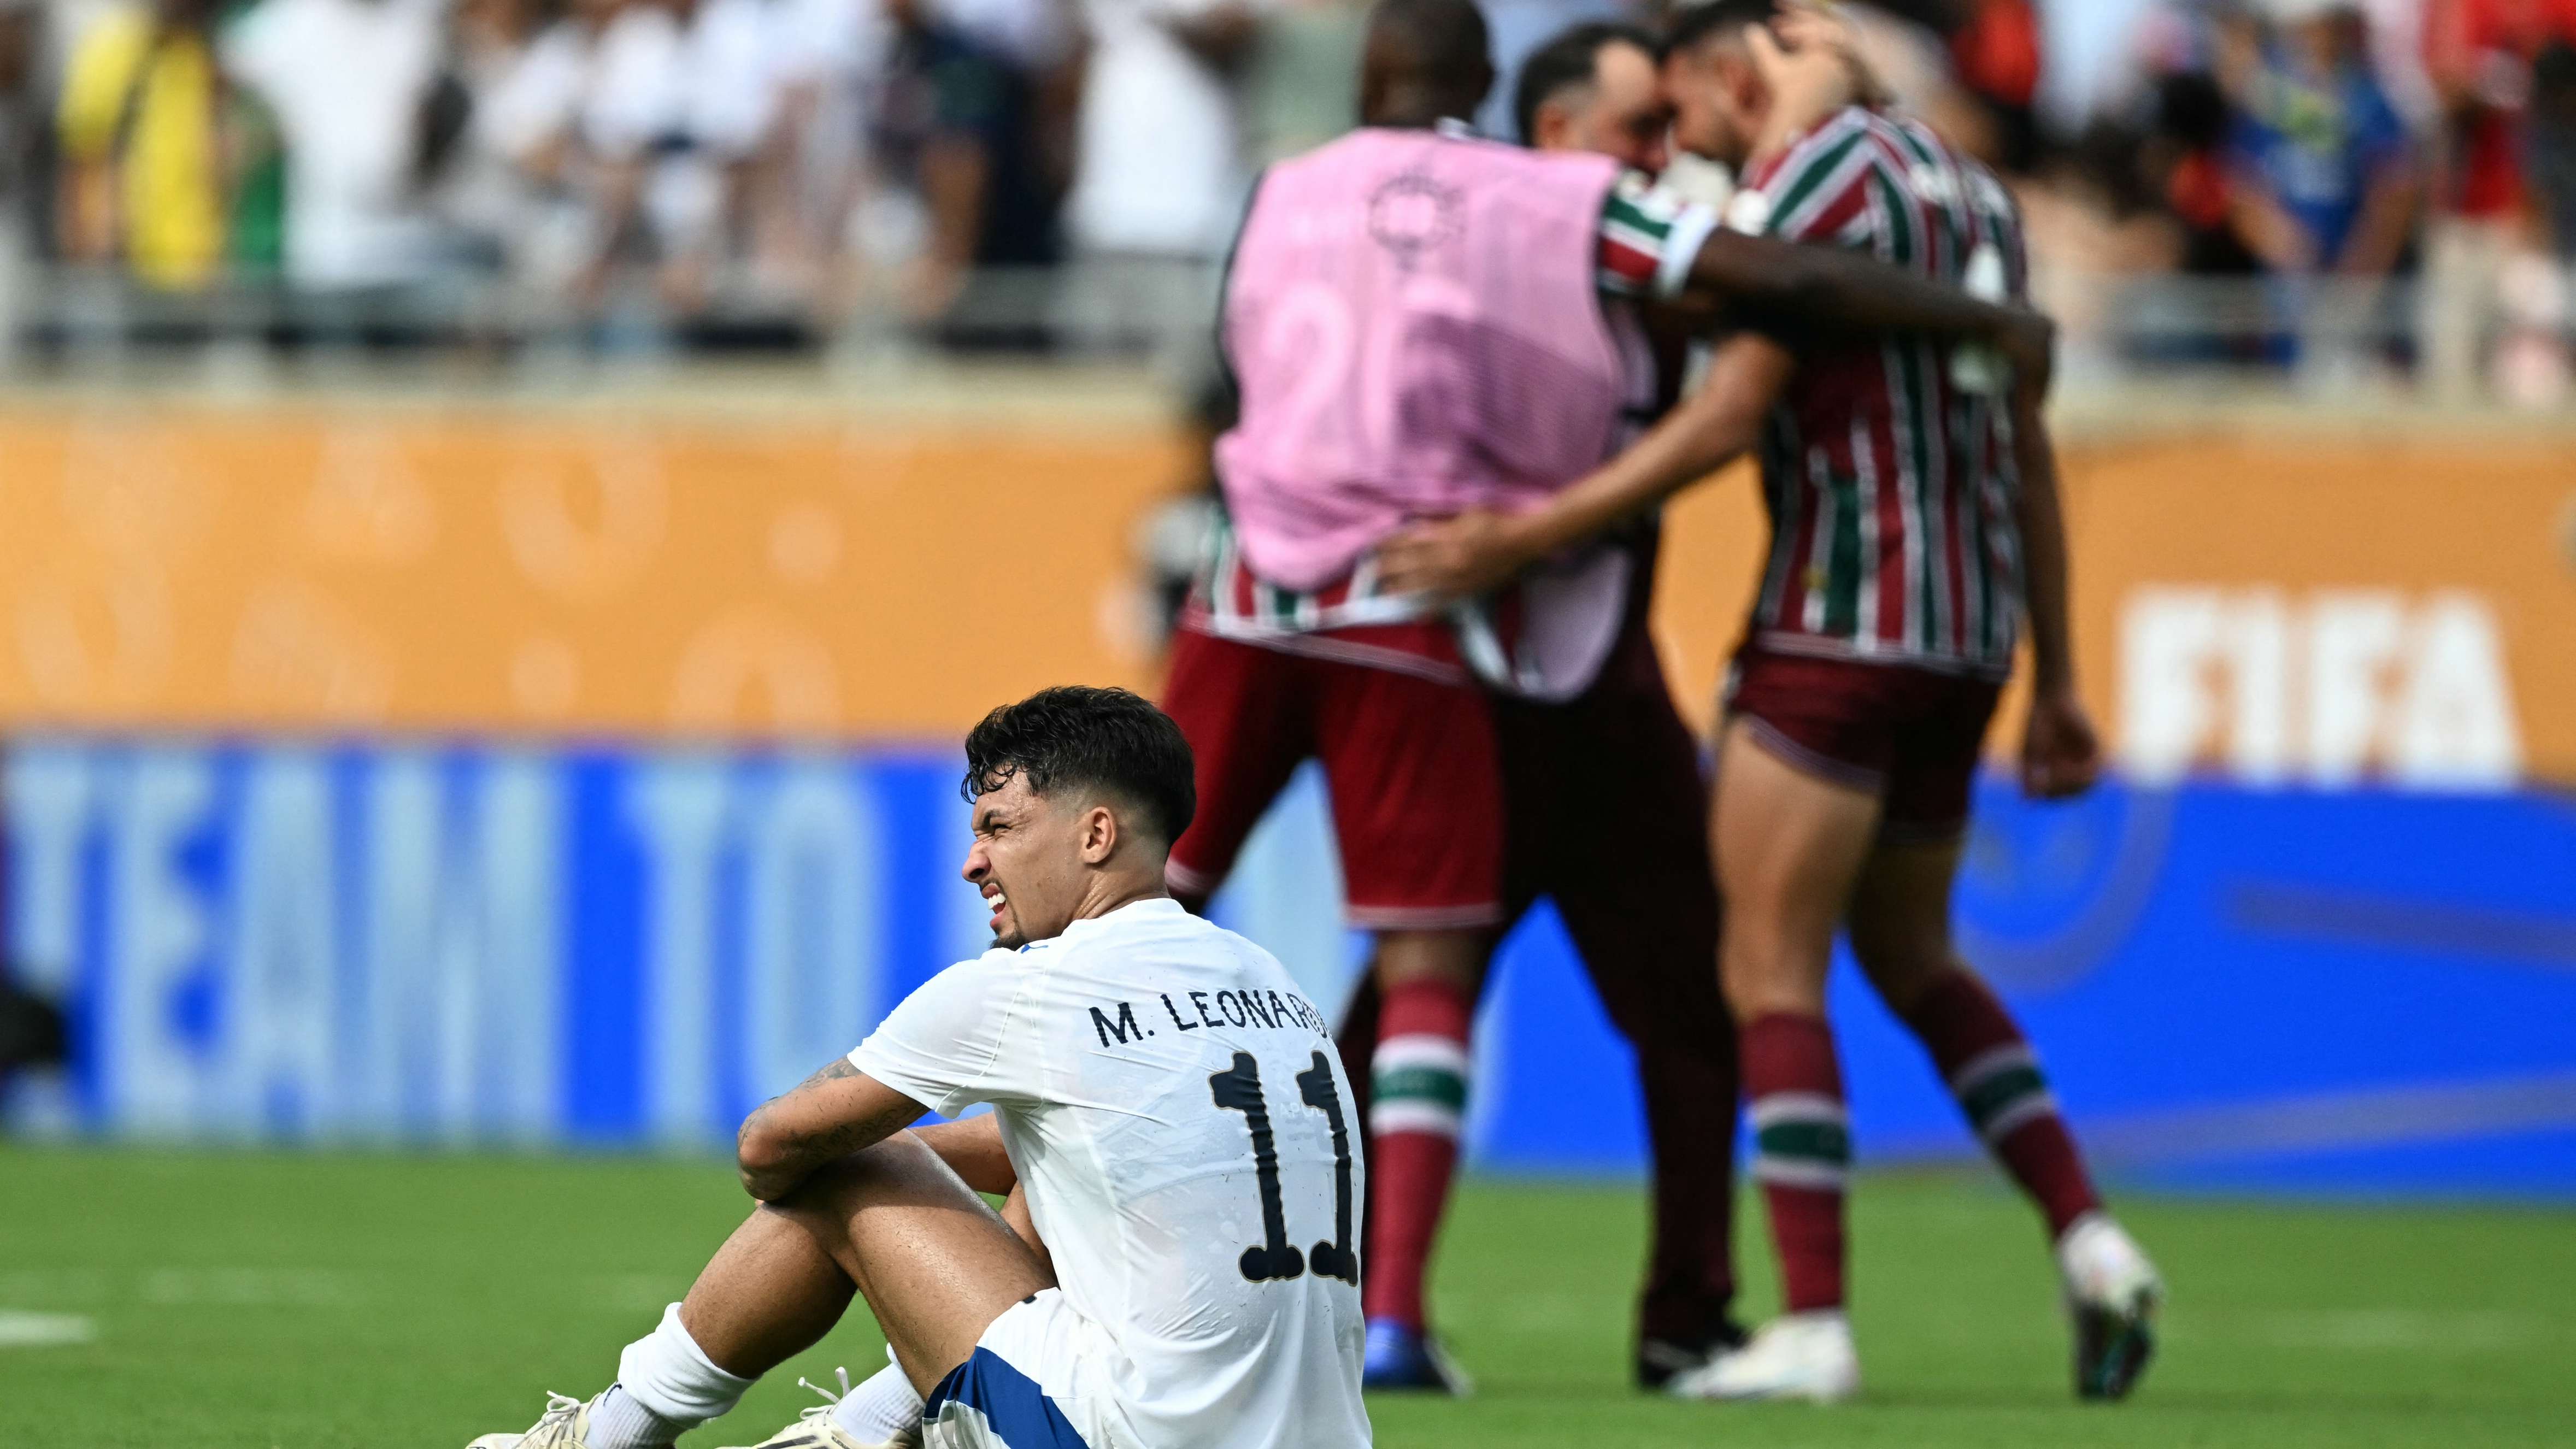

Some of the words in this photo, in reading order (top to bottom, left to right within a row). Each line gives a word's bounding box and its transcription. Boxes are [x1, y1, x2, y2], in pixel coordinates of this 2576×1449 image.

[2118, 586, 2524, 789] FIFA
[7, 747, 552, 1139] TEAM
[623, 753, 886, 1139] TO
[1089, 1003, 1155, 1047] M.
[1207, 1050, 1358, 1287] 11
